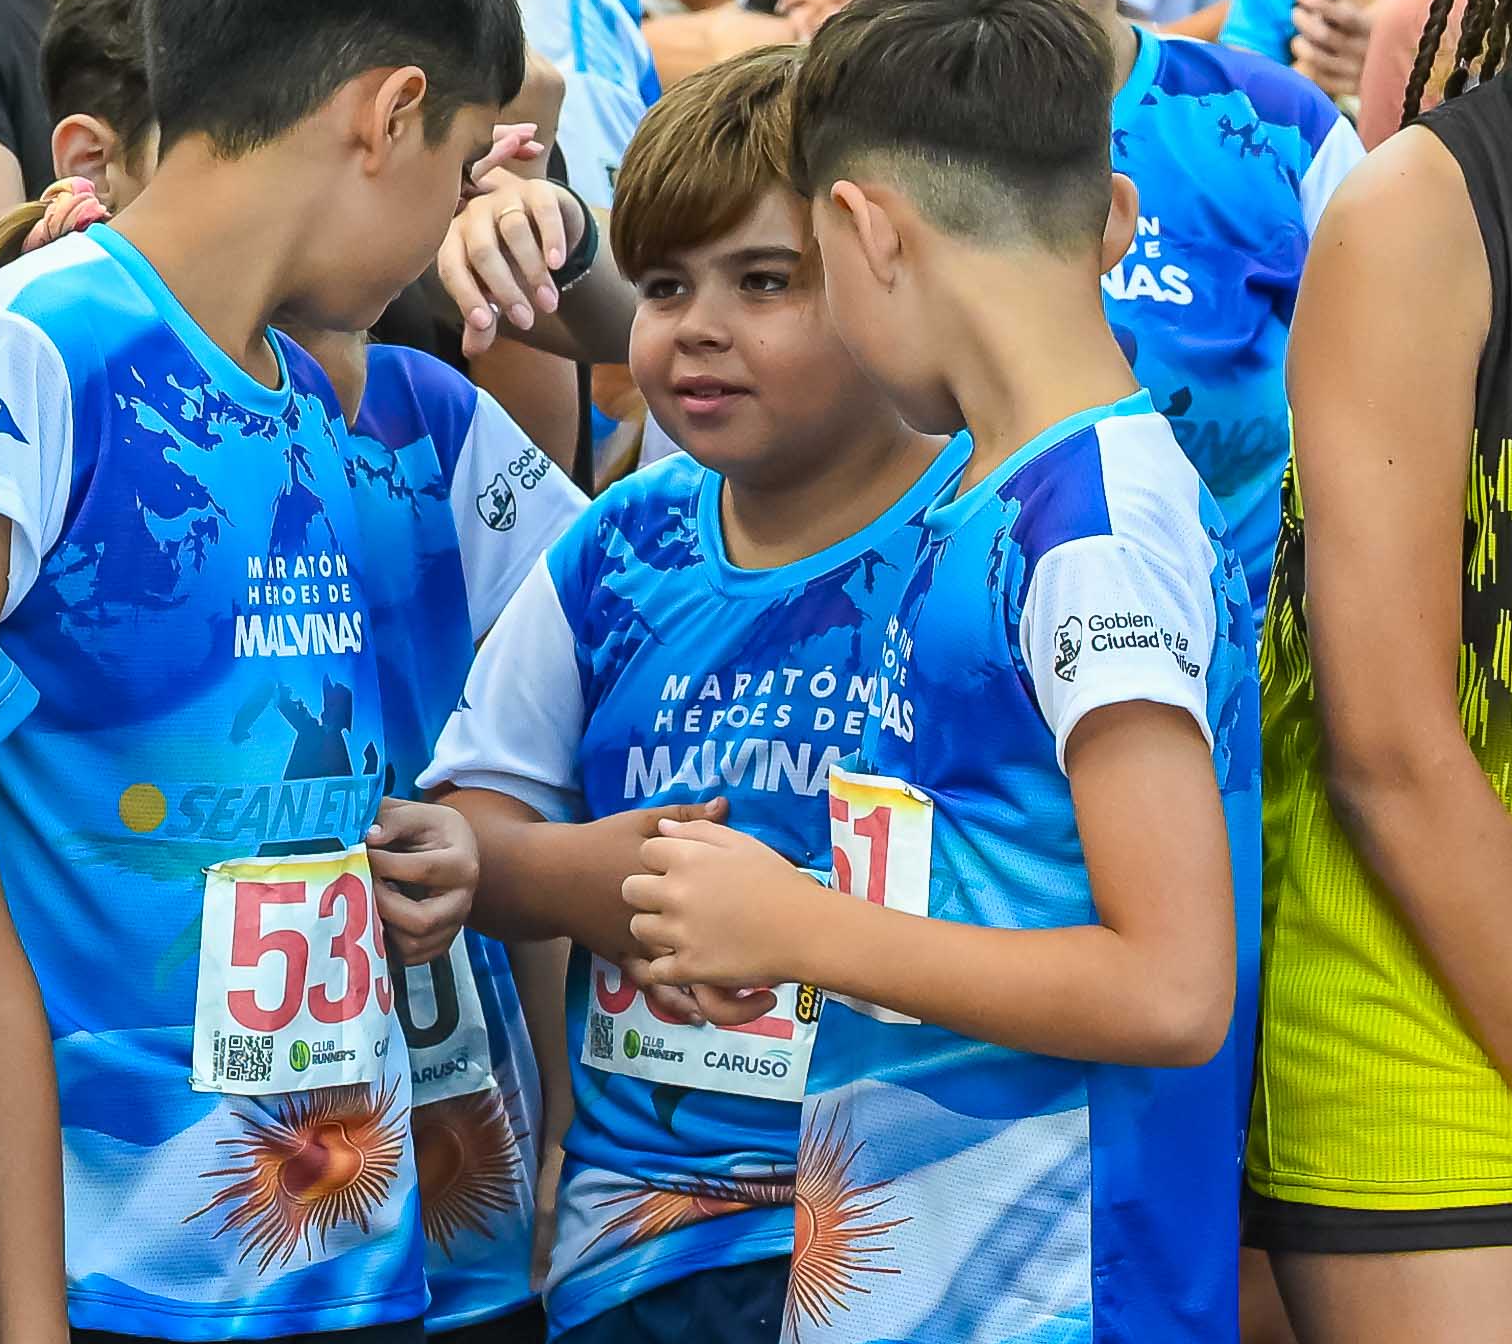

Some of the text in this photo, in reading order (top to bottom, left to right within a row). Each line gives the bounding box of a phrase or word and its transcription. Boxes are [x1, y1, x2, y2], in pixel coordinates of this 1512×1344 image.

[247, 550, 349, 578] MARATÓN
[248, 581, 352, 605] HÉROES DE
[234, 611, 362, 658] MALVINAS
[1091, 632, 1160, 652] Ciudad
[661, 665, 872, 702] MARATÓN
[814, 707, 864, 735] DE
[311, 1040, 335, 1052] CLUB
[642, 1035, 665, 1049] CLUB
[311, 1049, 356, 1065] RUNNER'S
[703, 1051, 789, 1078] CARUSO
